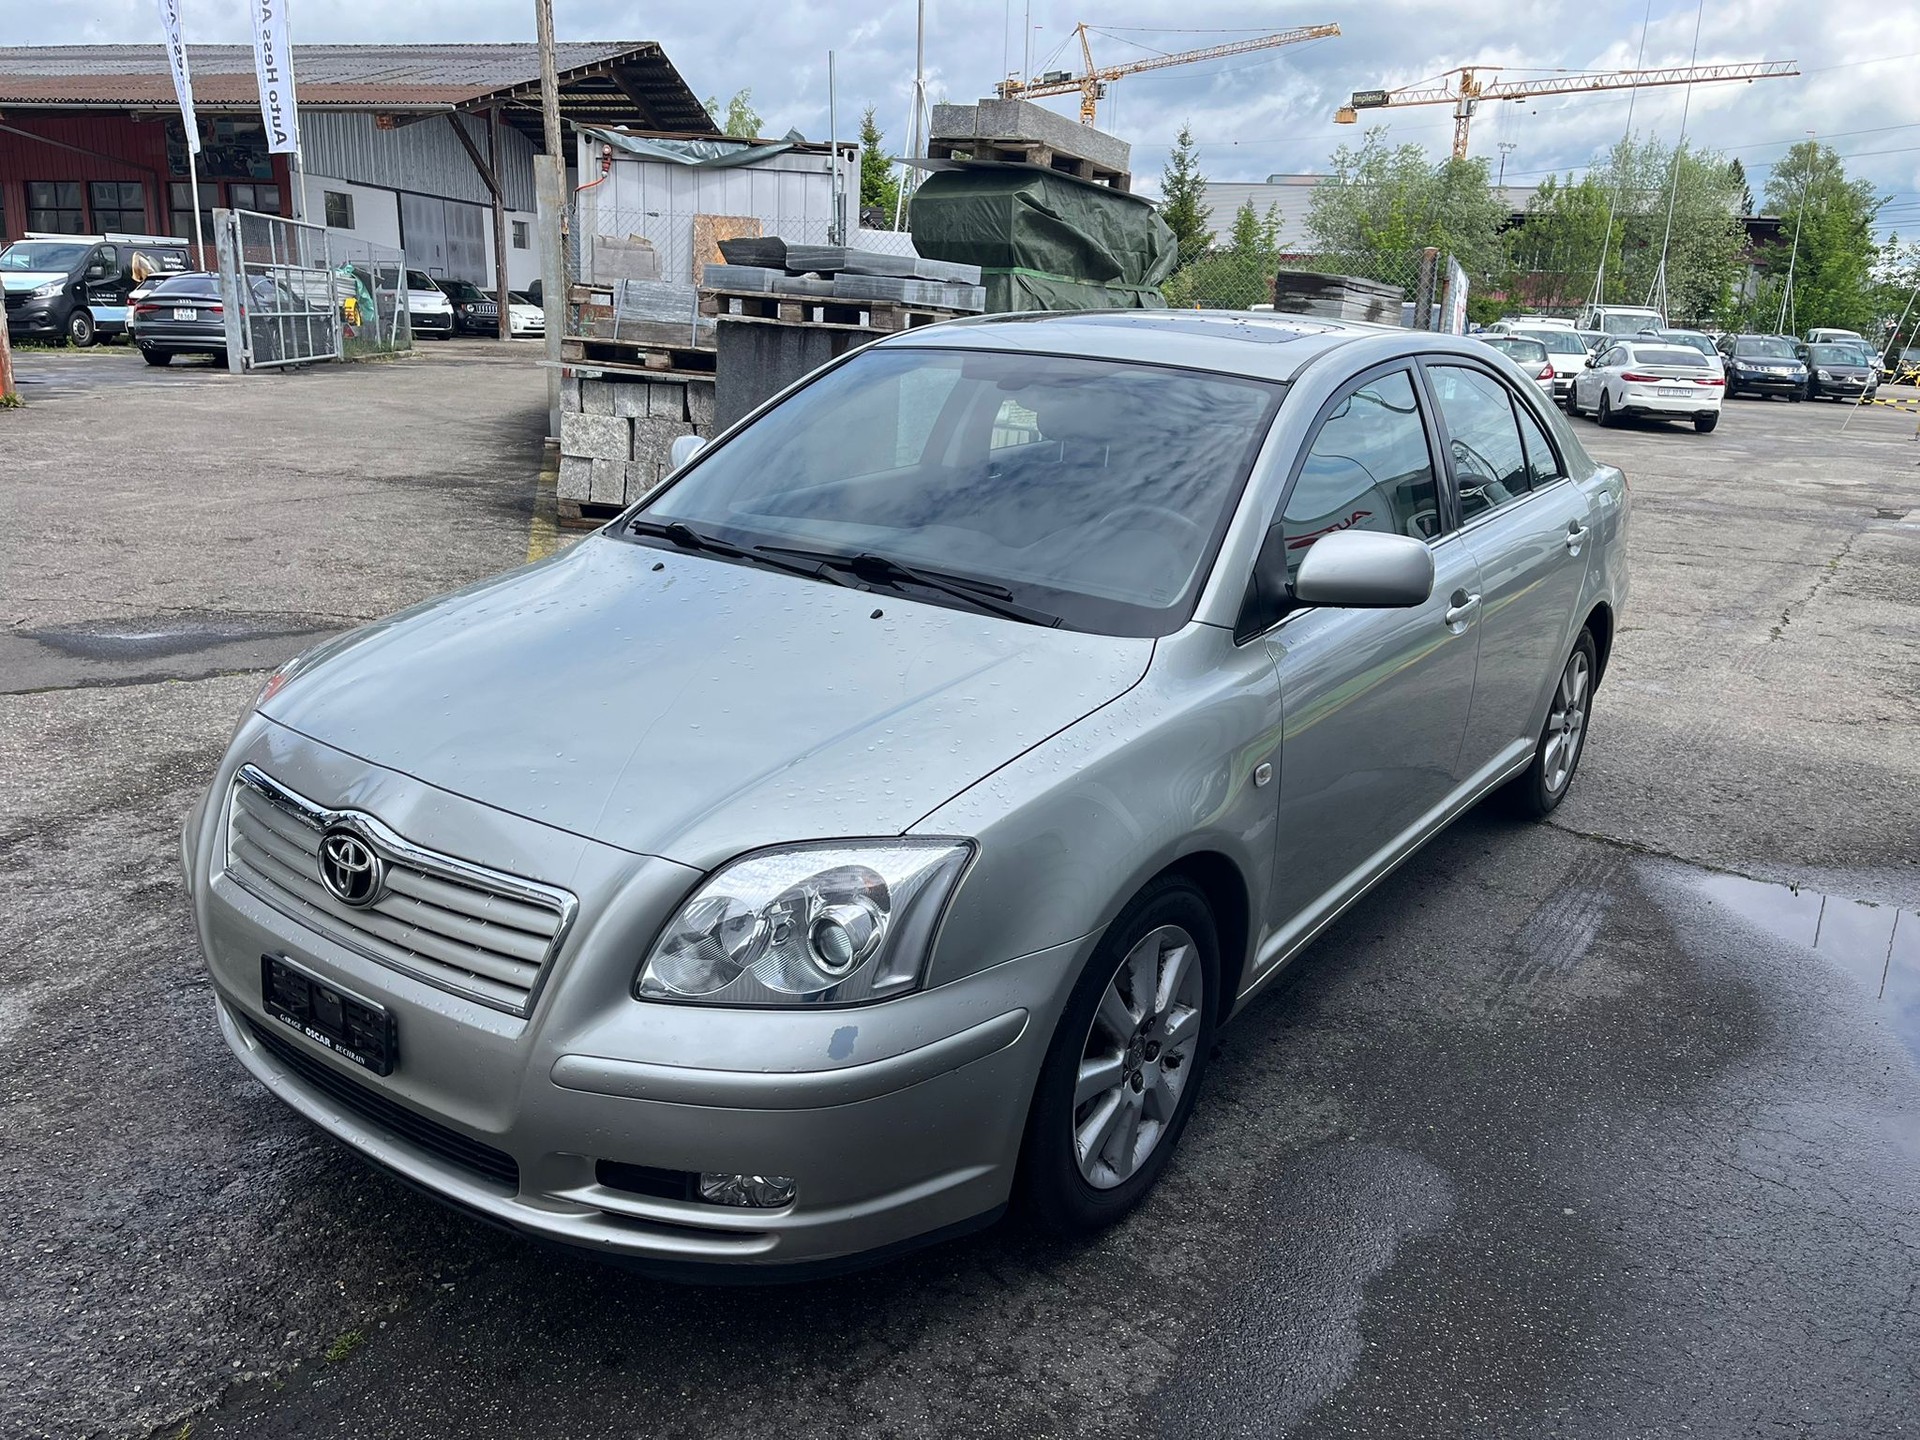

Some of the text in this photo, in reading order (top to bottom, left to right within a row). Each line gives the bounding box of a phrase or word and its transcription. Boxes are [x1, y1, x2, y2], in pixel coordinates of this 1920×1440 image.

[280, 1013, 365, 1064] GARAGE OSCAR BUCHRAIN
